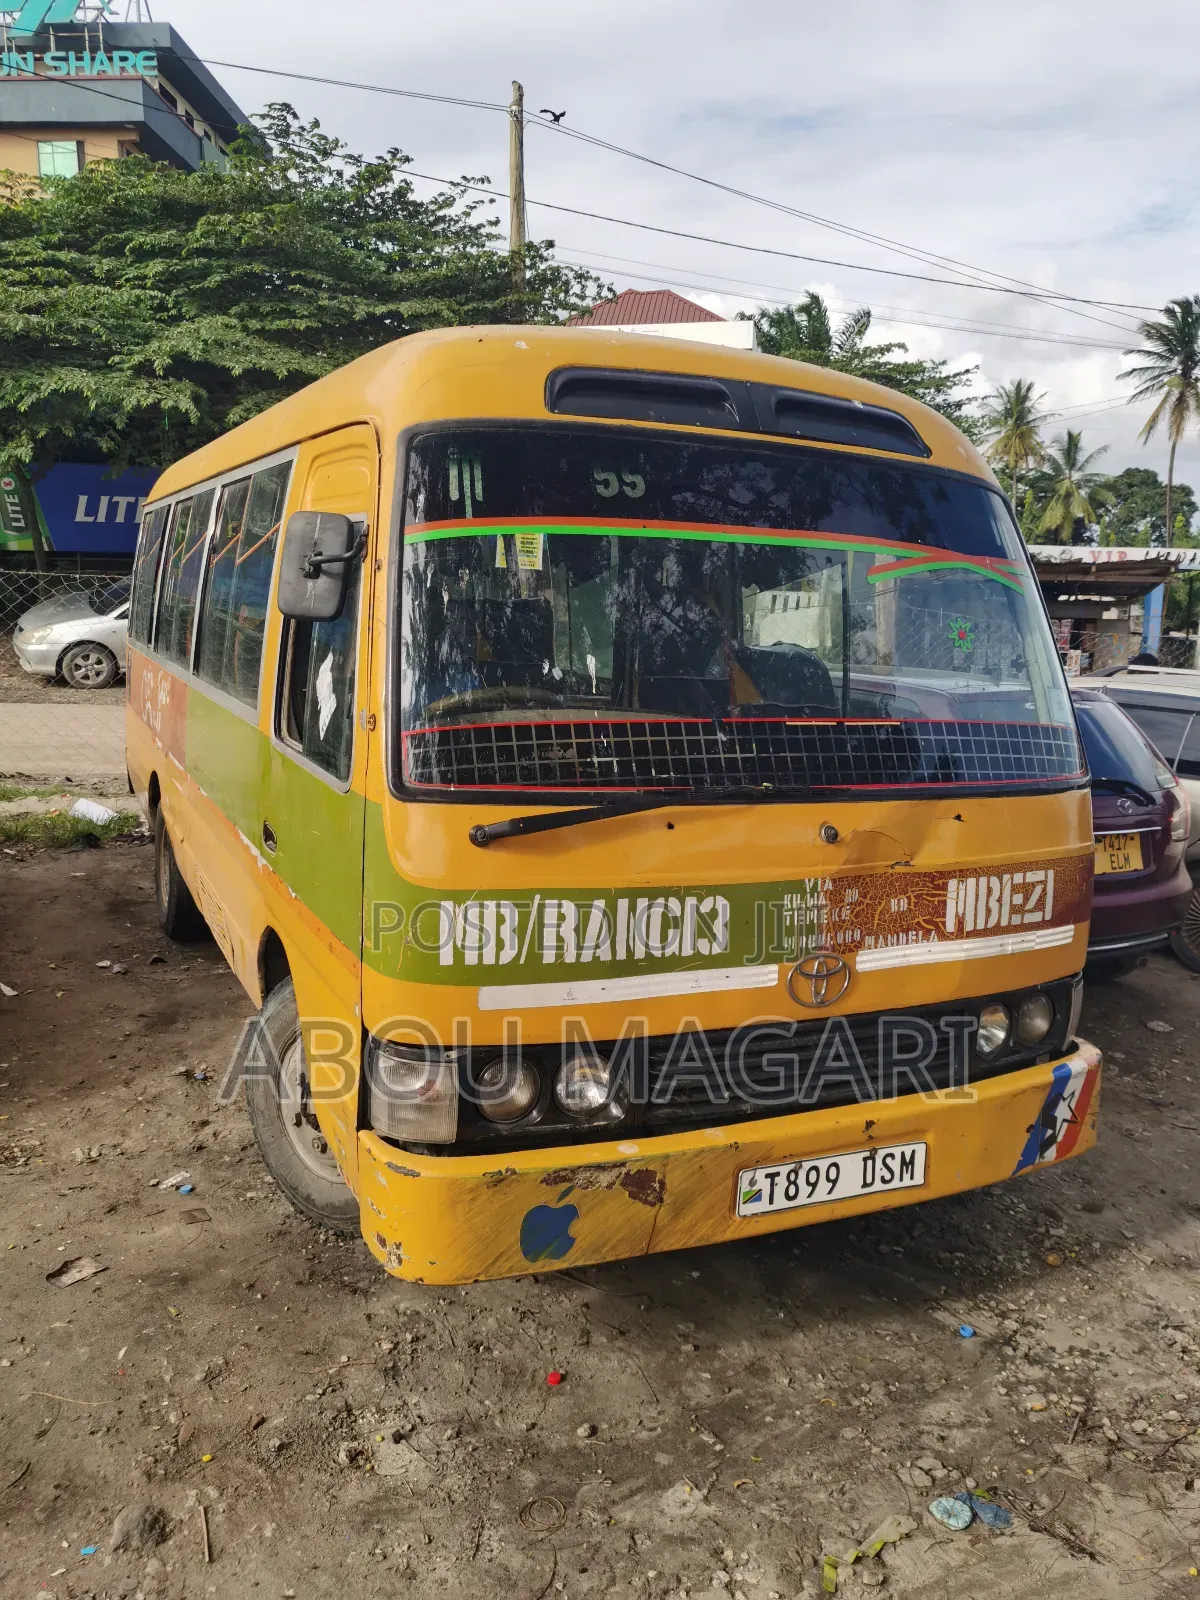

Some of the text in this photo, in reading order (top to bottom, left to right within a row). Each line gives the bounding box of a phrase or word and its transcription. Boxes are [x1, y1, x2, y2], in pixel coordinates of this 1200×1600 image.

[43, 50, 158, 77] SHARE
[4, 493, 26, 528] LITE
[1109, 852, 1131, 870] ELM
[945, 869, 1055, 933] MBEZI
[864, 930, 938, 950] MANDELA
[764, 1149, 916, 1206] T899 DSM
